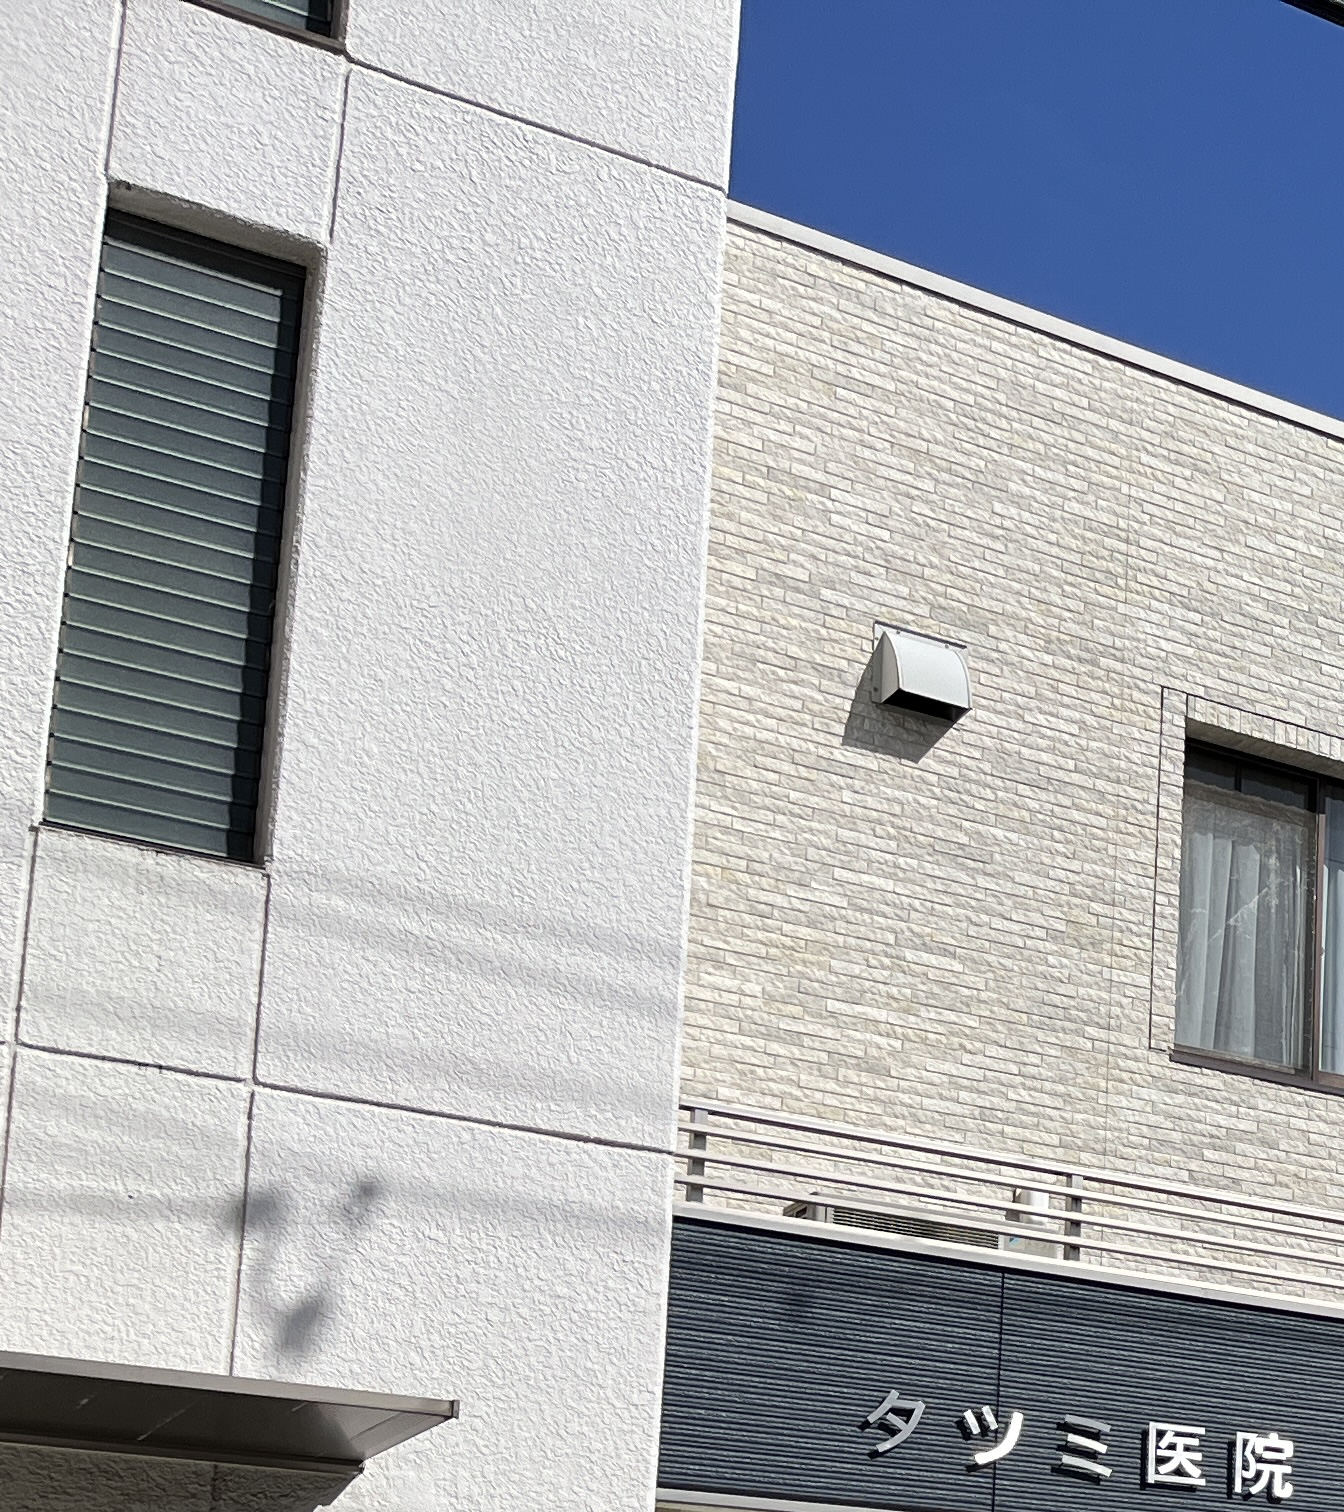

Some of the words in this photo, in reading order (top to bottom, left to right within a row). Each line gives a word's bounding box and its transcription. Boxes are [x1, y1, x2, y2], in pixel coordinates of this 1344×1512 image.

[866, 1389, 1295, 1498] タツミ医院
